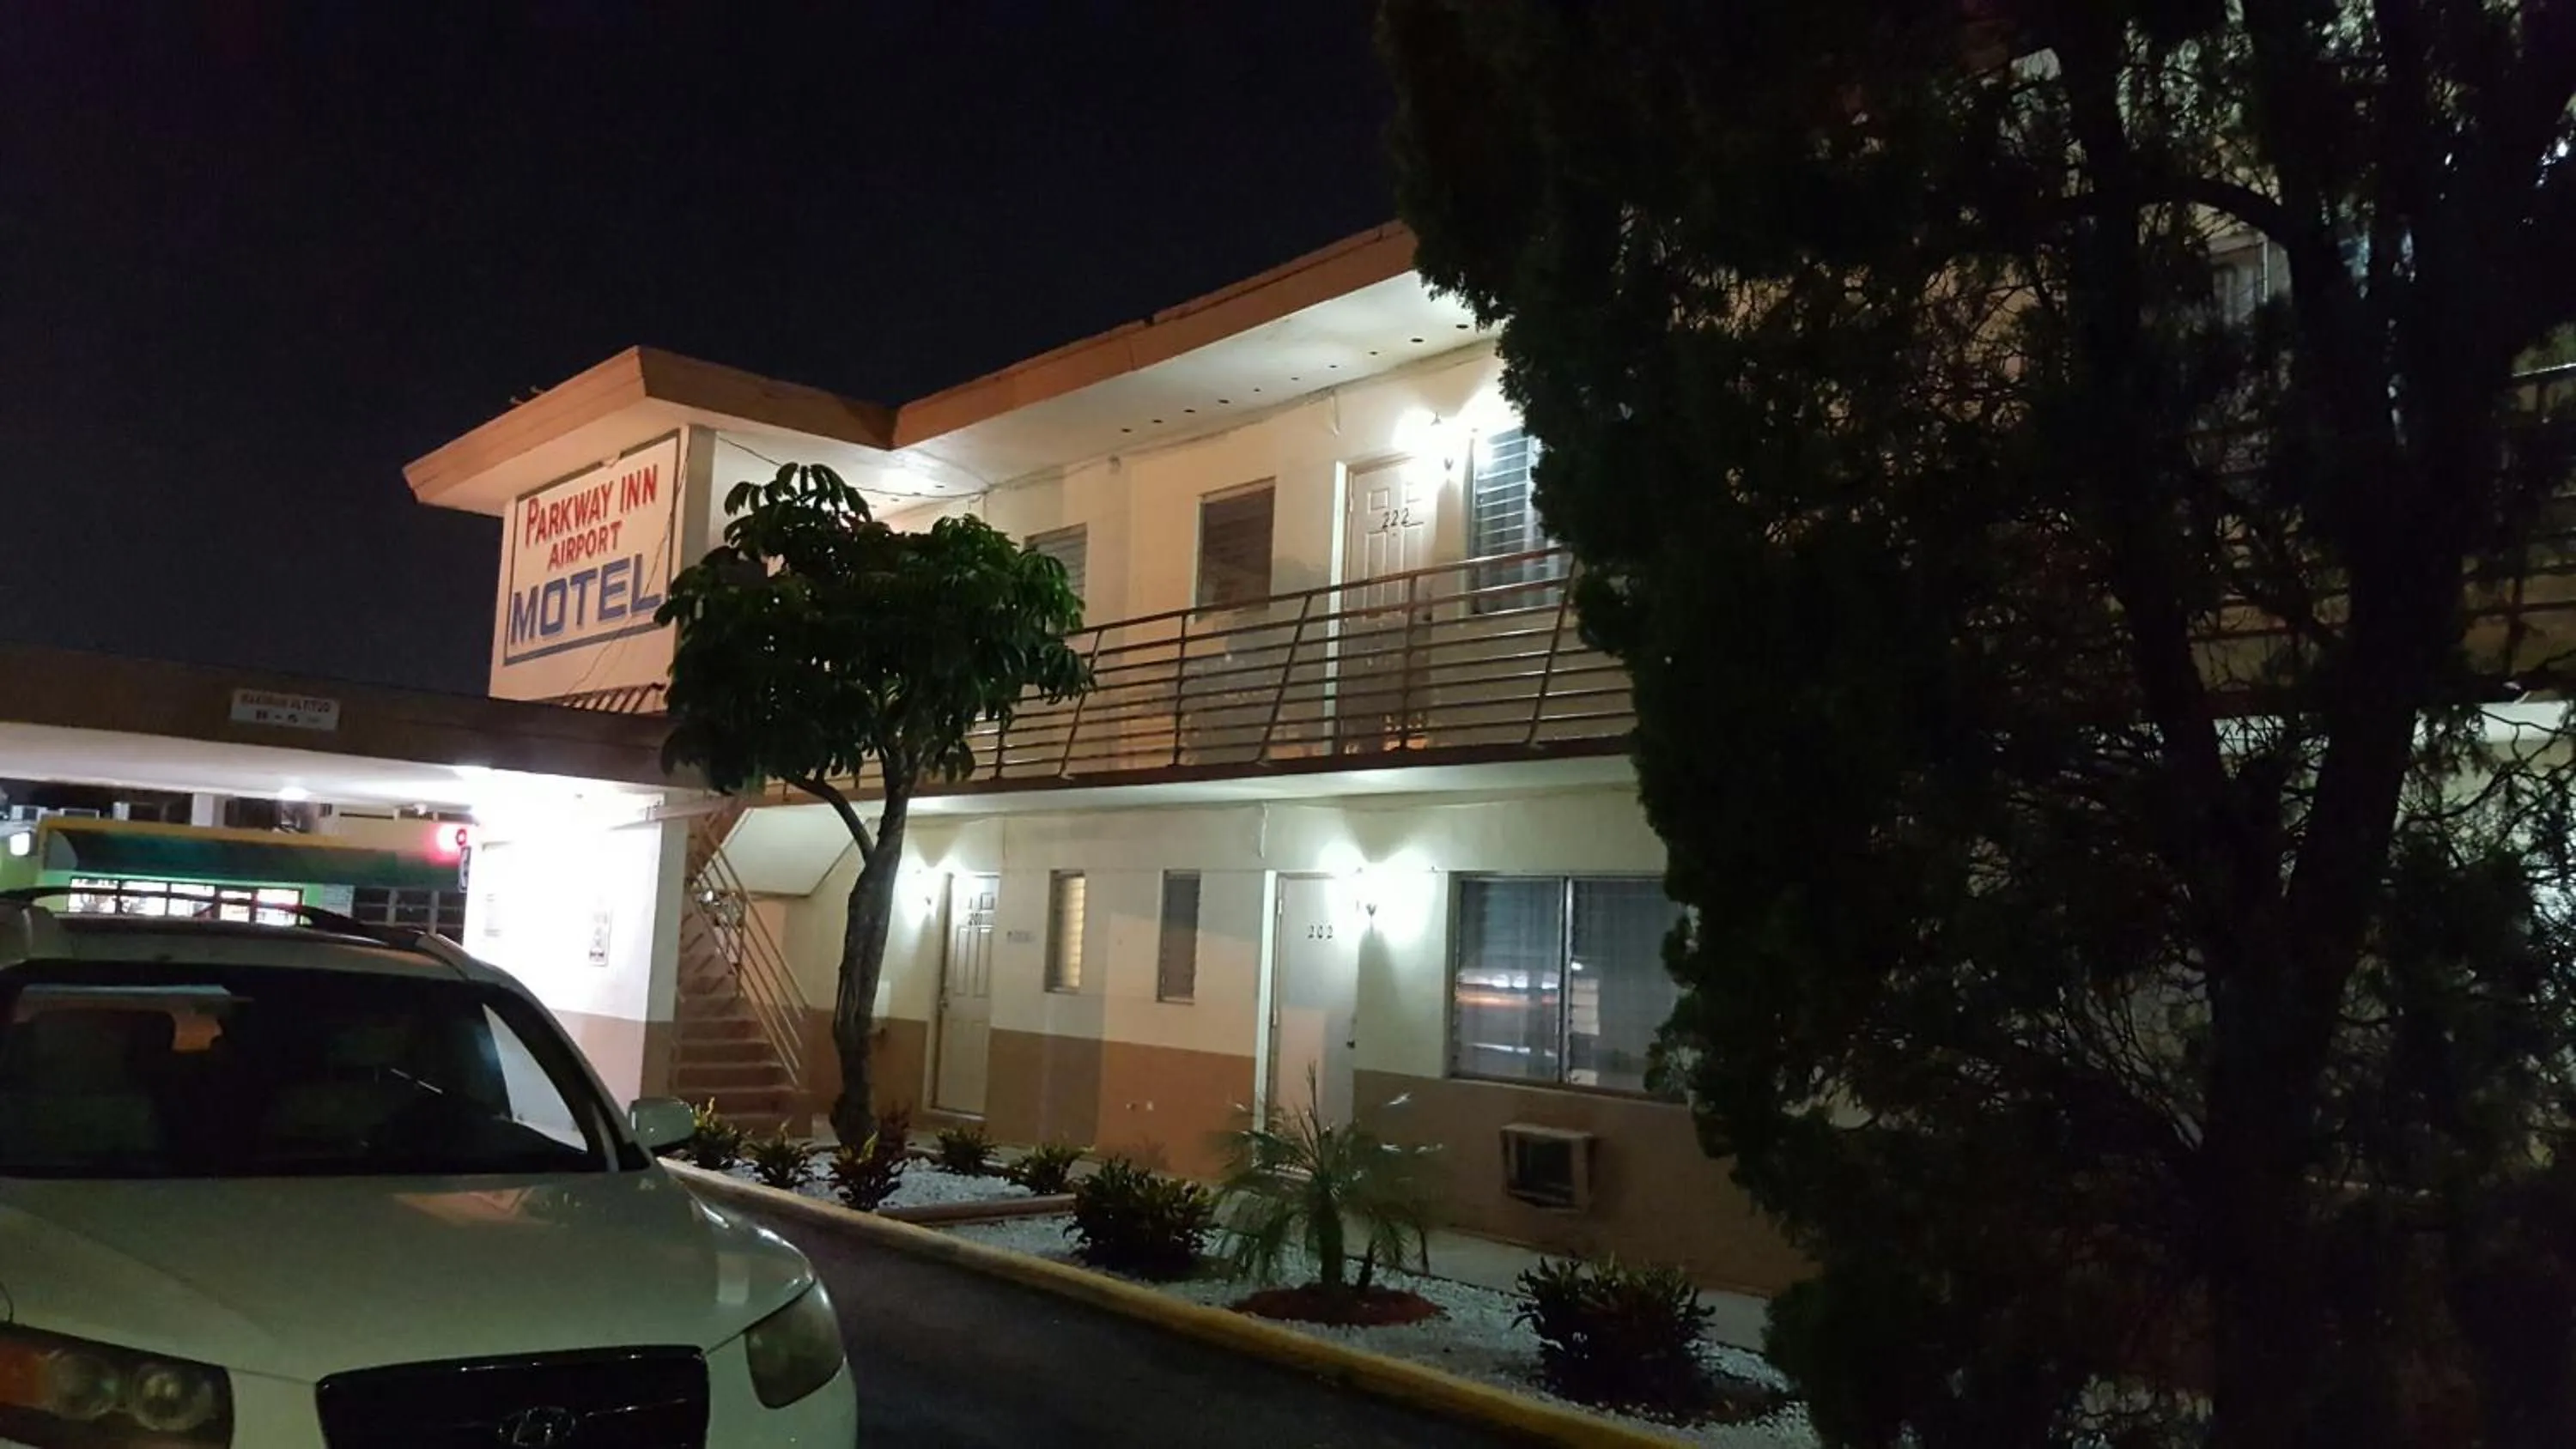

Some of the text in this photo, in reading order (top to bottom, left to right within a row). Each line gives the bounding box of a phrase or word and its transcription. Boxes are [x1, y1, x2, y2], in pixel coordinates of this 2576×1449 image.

[526, 464, 659, 549] PARKWAY INN
[1382, 508, 1410, 529] 222
[547, 521, 623, 572] AIRPORT
[510, 554, 662, 646] MOTEL
[1307, 925, 1334, 940] 202
